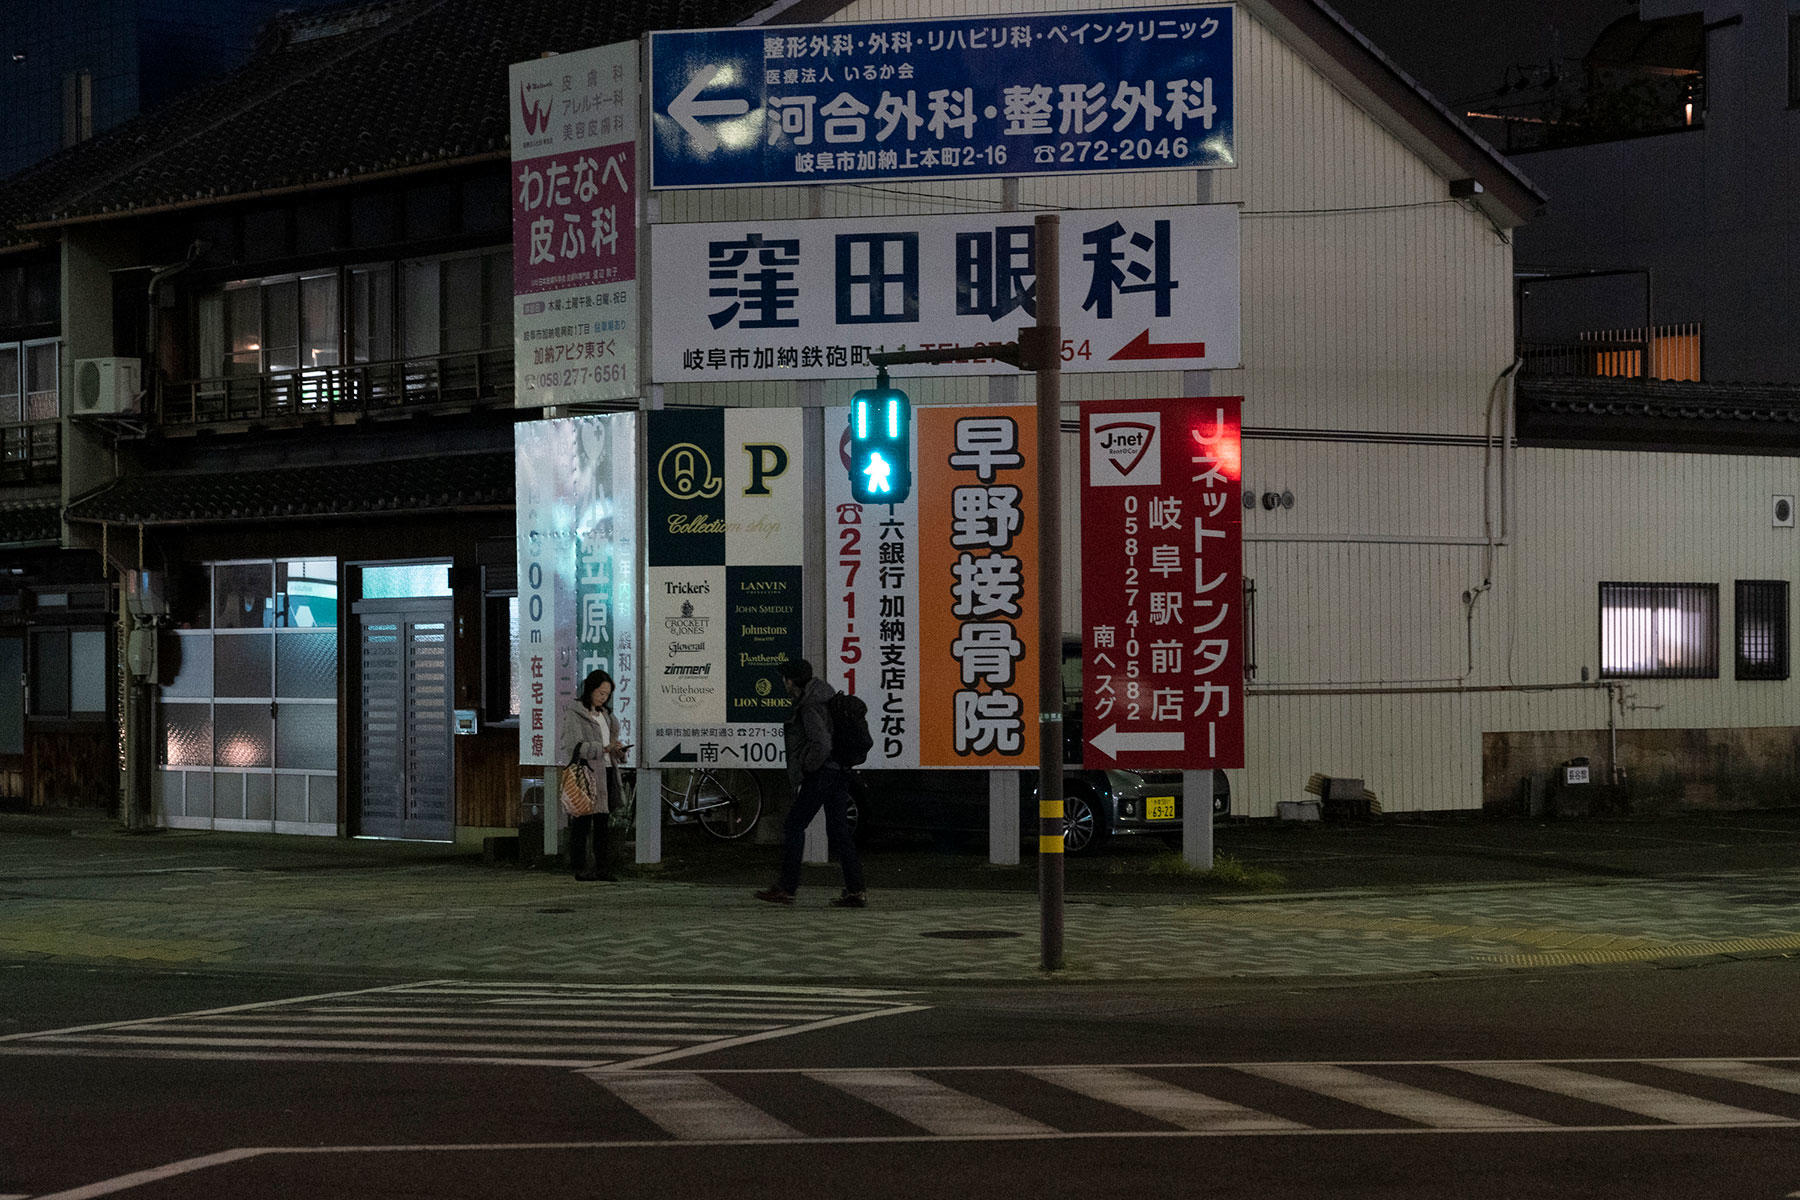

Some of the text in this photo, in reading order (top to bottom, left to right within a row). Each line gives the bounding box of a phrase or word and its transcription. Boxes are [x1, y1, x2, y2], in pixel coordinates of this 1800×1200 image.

[766, 62, 914, 84] 医療法人 いるか会
[562, 88, 623, 116] アレルギー科
[767, 77, 1217, 146] 河合外科・整形外科
[795, 144, 1007, 174] 岐阜市加納上本町2-16
[1059, 137, 1188, 163] 272-2046
[518, 151, 628, 212] わたなべ
[529, 204, 618, 265] 皮ふ科
[708, 220, 1179, 329] 窪田眼科
[742, 442, 789, 497] P
[664, 580, 710, 594] Tricker's
[740, 581, 787, 591] LANVIN
[948, 416, 1026, 757] 早野接骨院
[1191, 408, 1230, 758] Jネットレンタカー
[1124, 496, 1140, 721] 058-274-0582
[1149, 496, 1184, 721] 岐阜駅前店
[742, 624, 788, 637] Johnstons
[661, 684, 714, 694] Whitehouse
[664, 664, 711, 675] zimmerli
[1093, 624, 1116, 720] 南へスグ
[733, 697, 793, 708] LION SHOES
